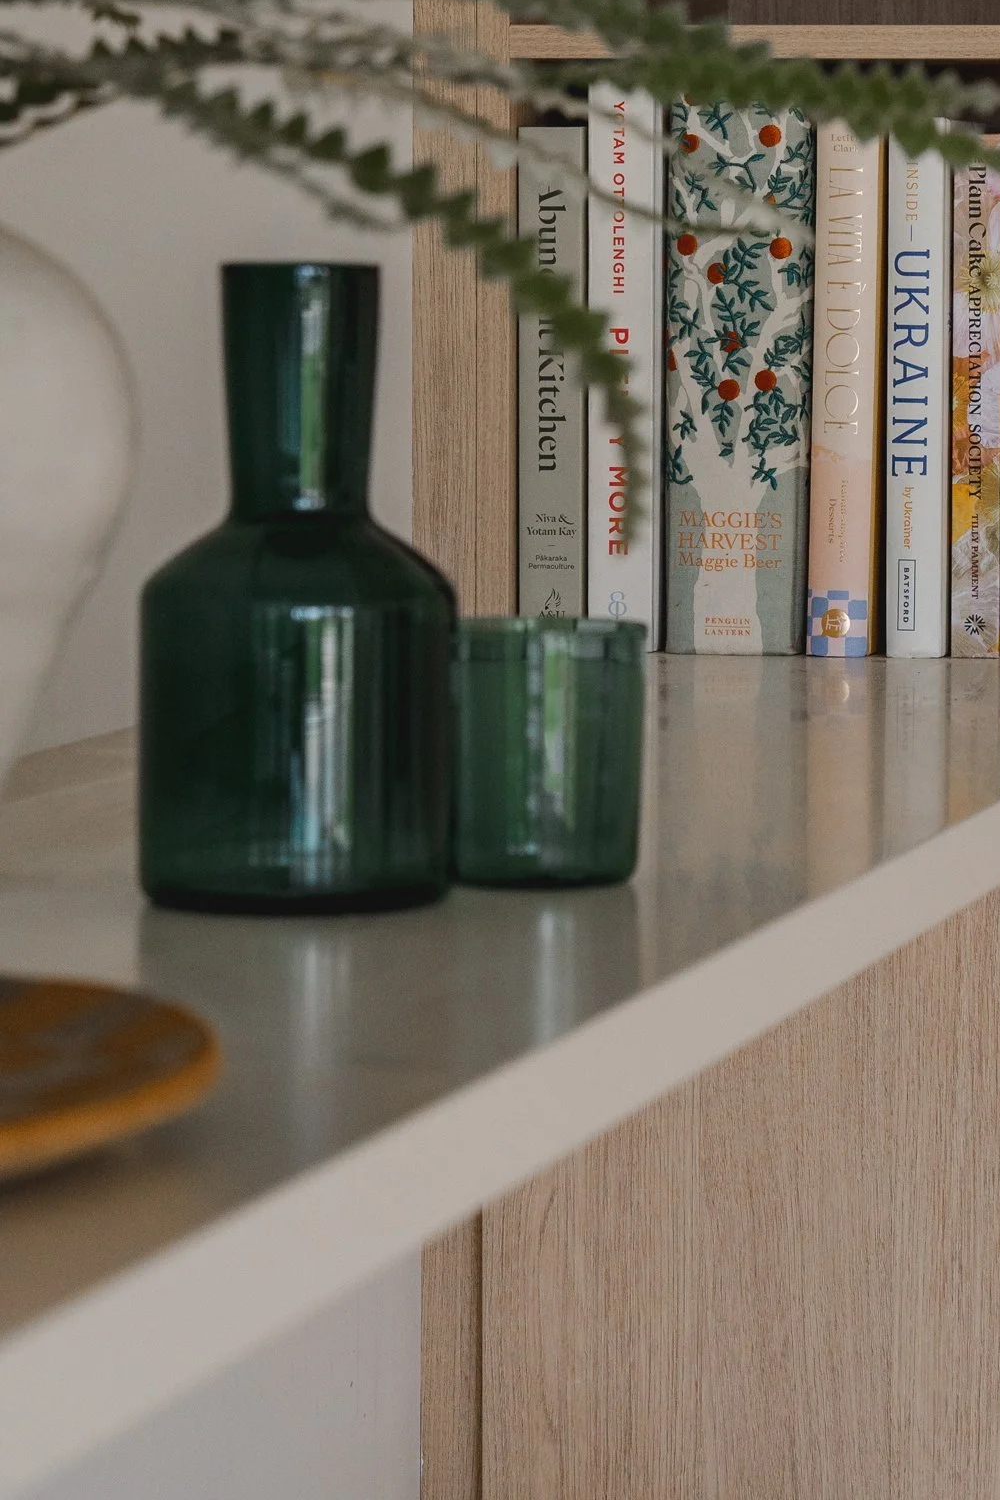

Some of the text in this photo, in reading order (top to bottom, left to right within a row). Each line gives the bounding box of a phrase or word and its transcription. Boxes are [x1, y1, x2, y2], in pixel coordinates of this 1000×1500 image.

[828, 168, 864, 199] LA
[968, 166, 987, 218] Plain
[827, 213, 863, 267] VITA
[968, 223, 987, 278] Cake
[823, 308, 861, 435] DOLCE
[891, 249, 930, 477] UKRAINE
[968, 284, 982, 415] APPRECIATION
[538, 346, 567, 472] Kitchen
[968, 425, 982, 500] SOCIETY
[608, 466, 629, 556] MORE
[902, 486, 914, 500] by
[526, 526, 577, 539] Yotam Kay
[535, 513, 575, 526] Niva &
[677, 532, 784, 551] HARVEST
[678, 511, 783, 529] MAGGIE'S
[528, 562, 575, 570] Permaculture
[678, 552, 783, 572] Maggie Beer
[971, 545, 979, 600] PAMMENT
[704, 617, 752, 625] PENGUIN
[902, 567, 910, 624] BATSFORD
[704, 628, 752, 636] LANTERN
